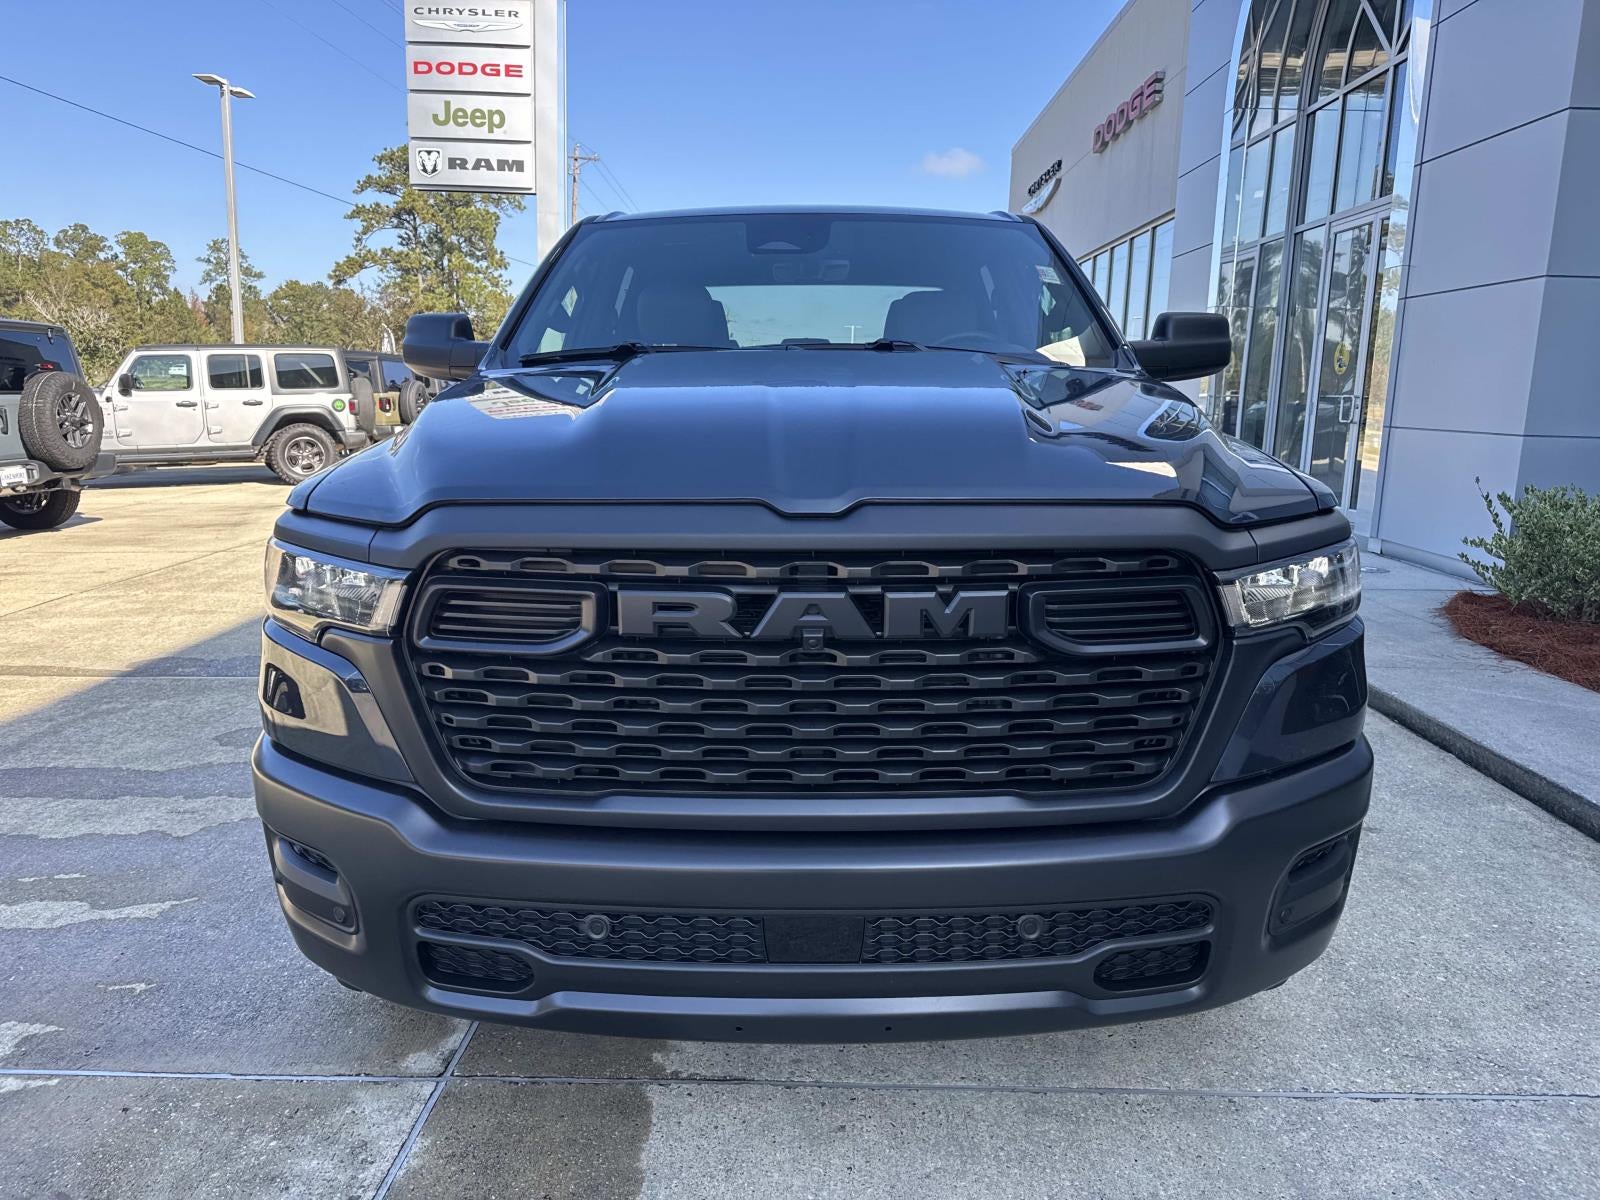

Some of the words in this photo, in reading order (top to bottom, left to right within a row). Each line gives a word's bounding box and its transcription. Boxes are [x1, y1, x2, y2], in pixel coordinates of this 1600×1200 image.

[413, 7, 520, 18] CHRYSLER
[413, 61, 524, 78] DODGE
[432, 100, 506, 134] Jeep
[1092, 70, 1166, 154] DODGE
[447, 157, 525, 173] RAM
[617, 589, 1010, 639] RAM
